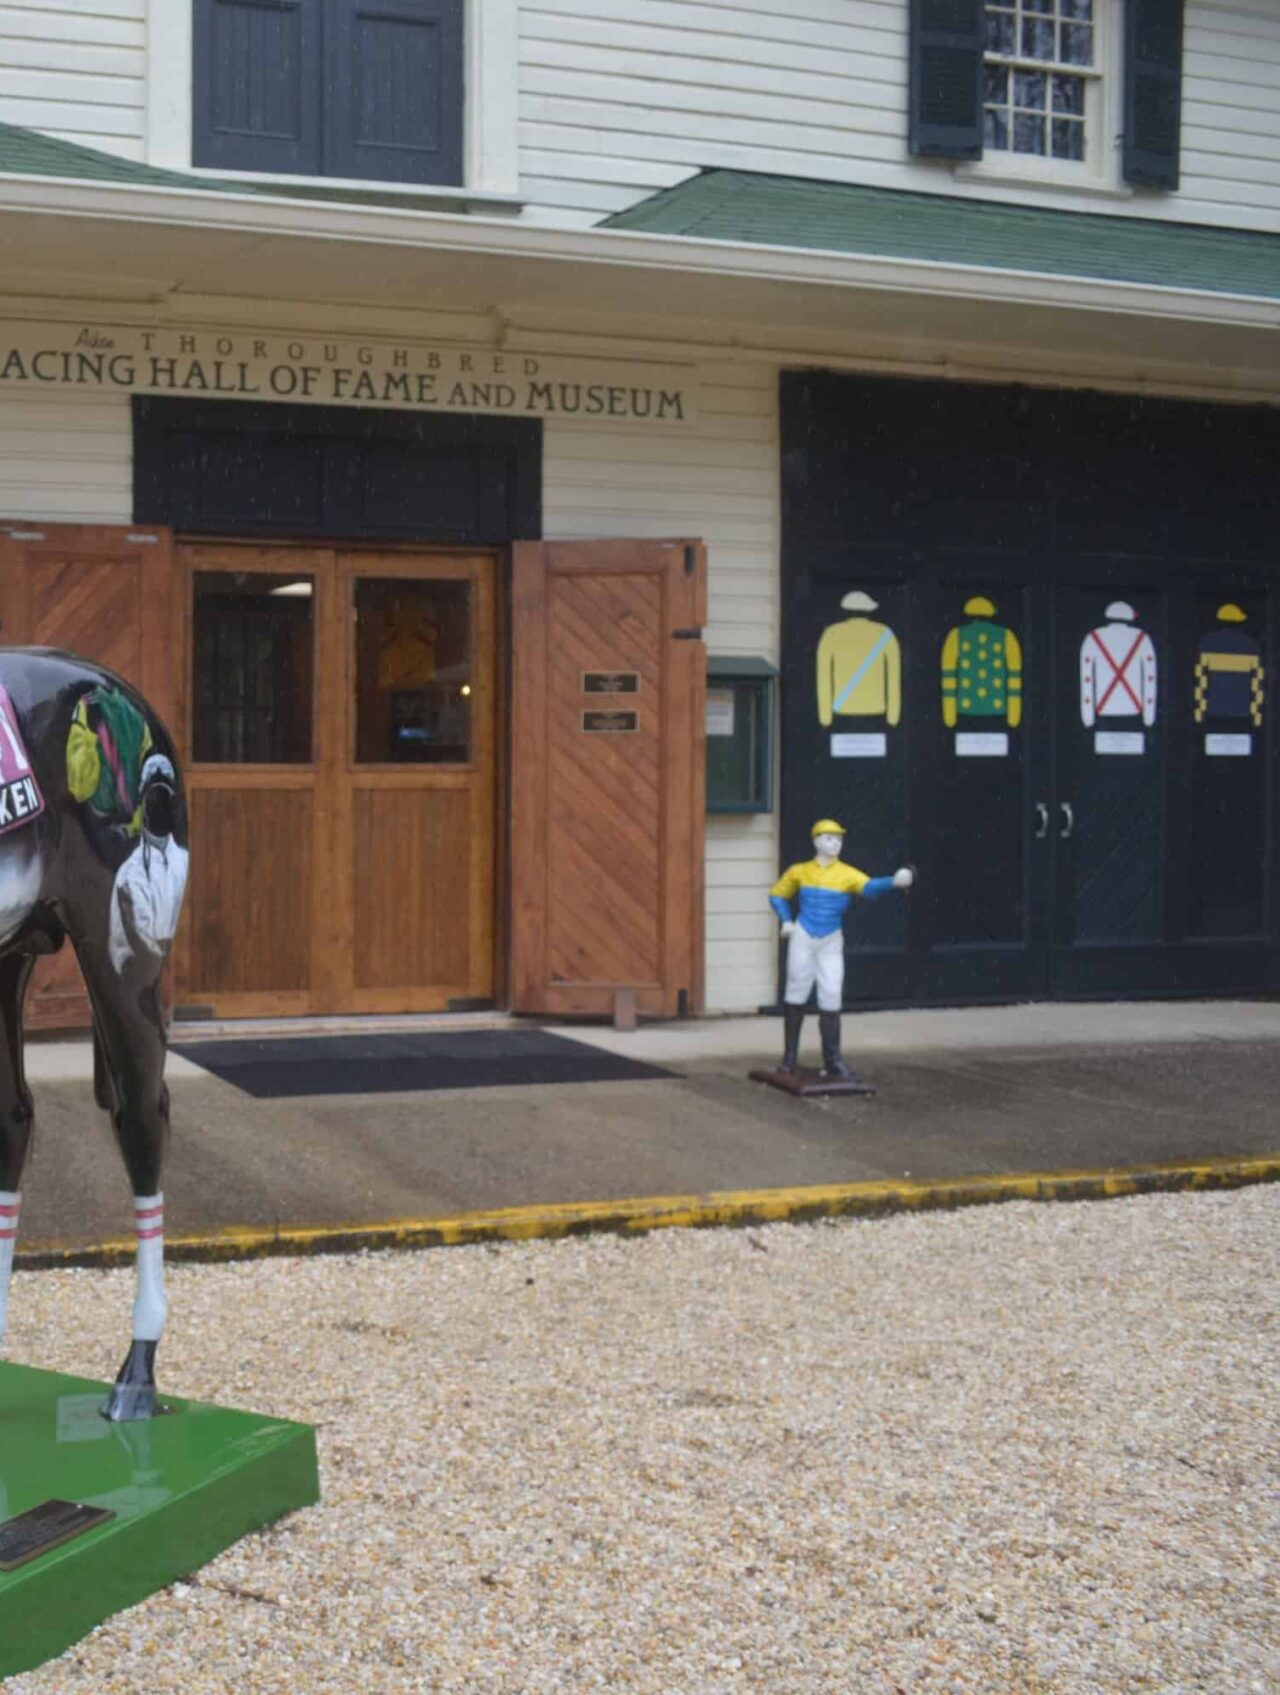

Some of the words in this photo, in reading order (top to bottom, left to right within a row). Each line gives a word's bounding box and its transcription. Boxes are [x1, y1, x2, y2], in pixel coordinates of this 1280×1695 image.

[140, 332, 539, 376] THOROUGHBRED
[149, 356, 259, 393] HALL
[269, 364, 321, 397] OF
[332, 368, 438, 405] FAME
[445, 381, 516, 408] AND
[525, 381, 685, 420] MUSEUM
